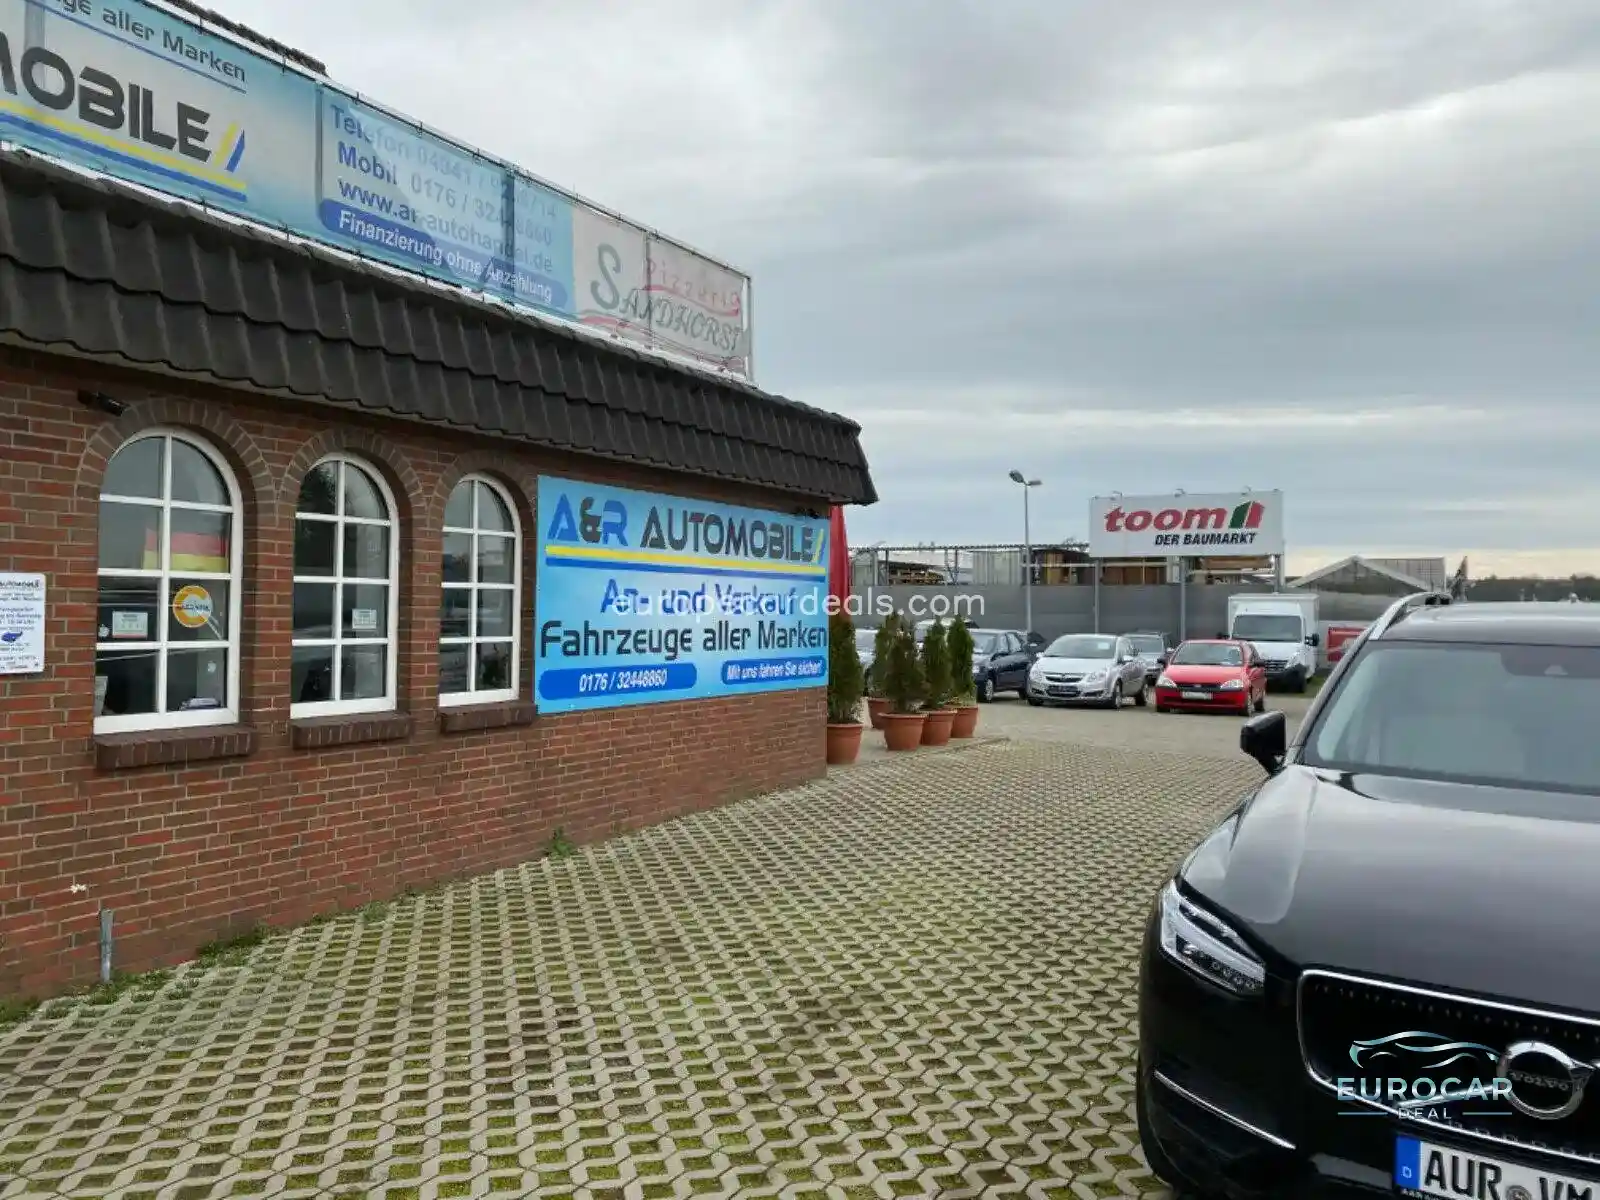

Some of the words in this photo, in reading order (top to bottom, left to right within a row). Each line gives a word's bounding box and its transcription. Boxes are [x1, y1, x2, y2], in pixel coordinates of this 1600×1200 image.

[56, 0, 92, 15] ge
[103, 8, 154, 41] aller
[163, 28, 245, 83] Marken
[411, 172, 456, 209] 0176
[338, 209, 443, 266] Finanzierung
[447, 249, 482, 276] ohne
[486, 262, 552, 304] Anzahlung
[547, 493, 628, 547] A&R
[640, 506, 814, 563] AUTOMOBILE
[1104, 505, 1228, 532] toom
[1155, 533, 1179, 546] DER
[1184, 532, 1257, 545] BAUMARKT
[540, 620, 692, 661] Fahrzeuge
[703, 620, 751, 651] aller
[758, 620, 827, 650] Marken
[579, 673, 608, 692] 0176
[727, 664, 741, 680] Mit
[742, 667, 757, 679] uns
[759, 662, 783, 678] fahren
[785, 661, 797, 676] Sie
[1424, 1150, 1503, 1200] AUR
